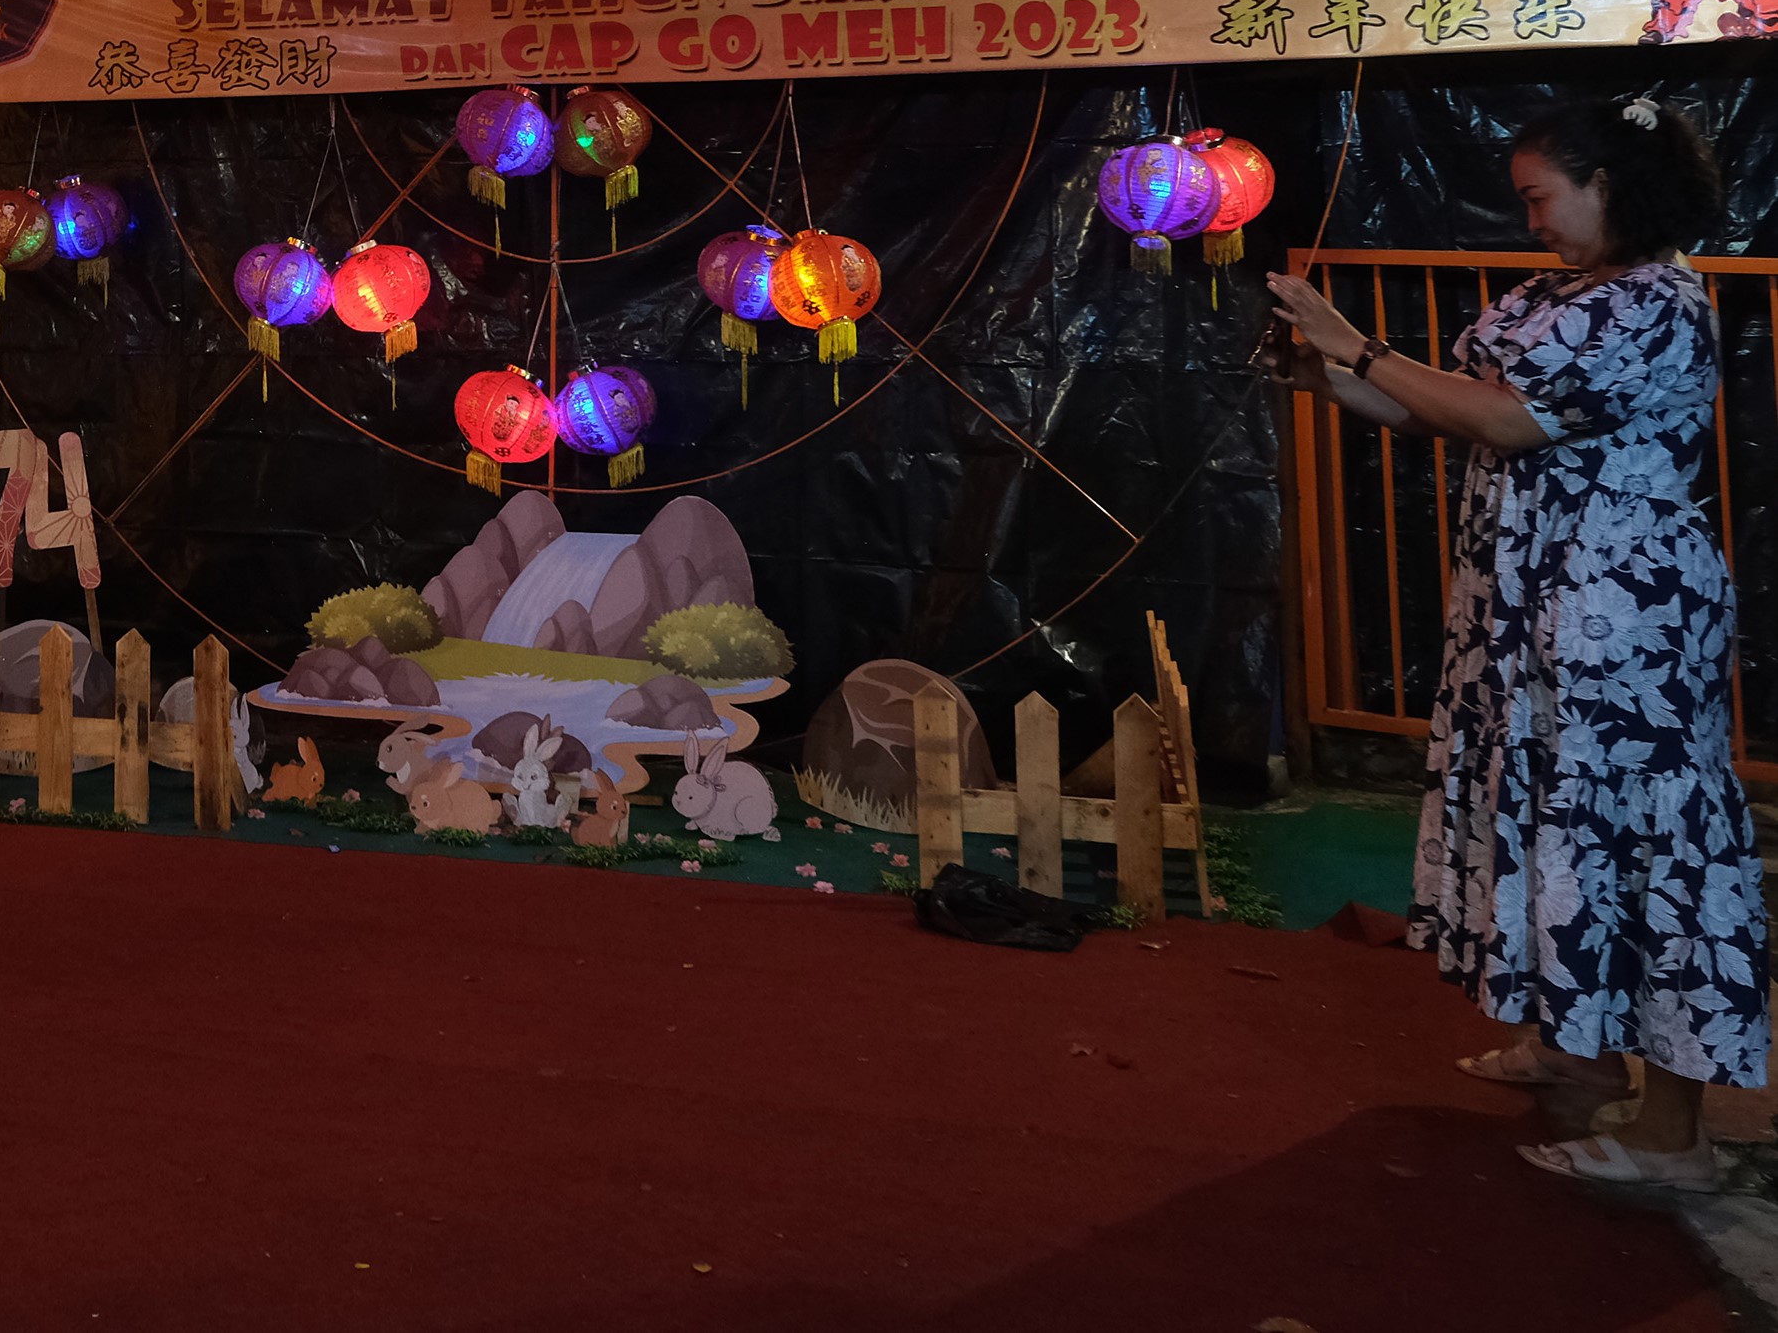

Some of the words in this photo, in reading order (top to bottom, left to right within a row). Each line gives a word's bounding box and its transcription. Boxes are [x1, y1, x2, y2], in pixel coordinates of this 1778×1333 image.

[88, 36, 337, 94] 恭喜發財
[399, 42, 492, 81] DAN
[500, 21, 640, 79] CAP
[657, 13, 760, 70] GO
[781, 5, 951, 65] MEH
